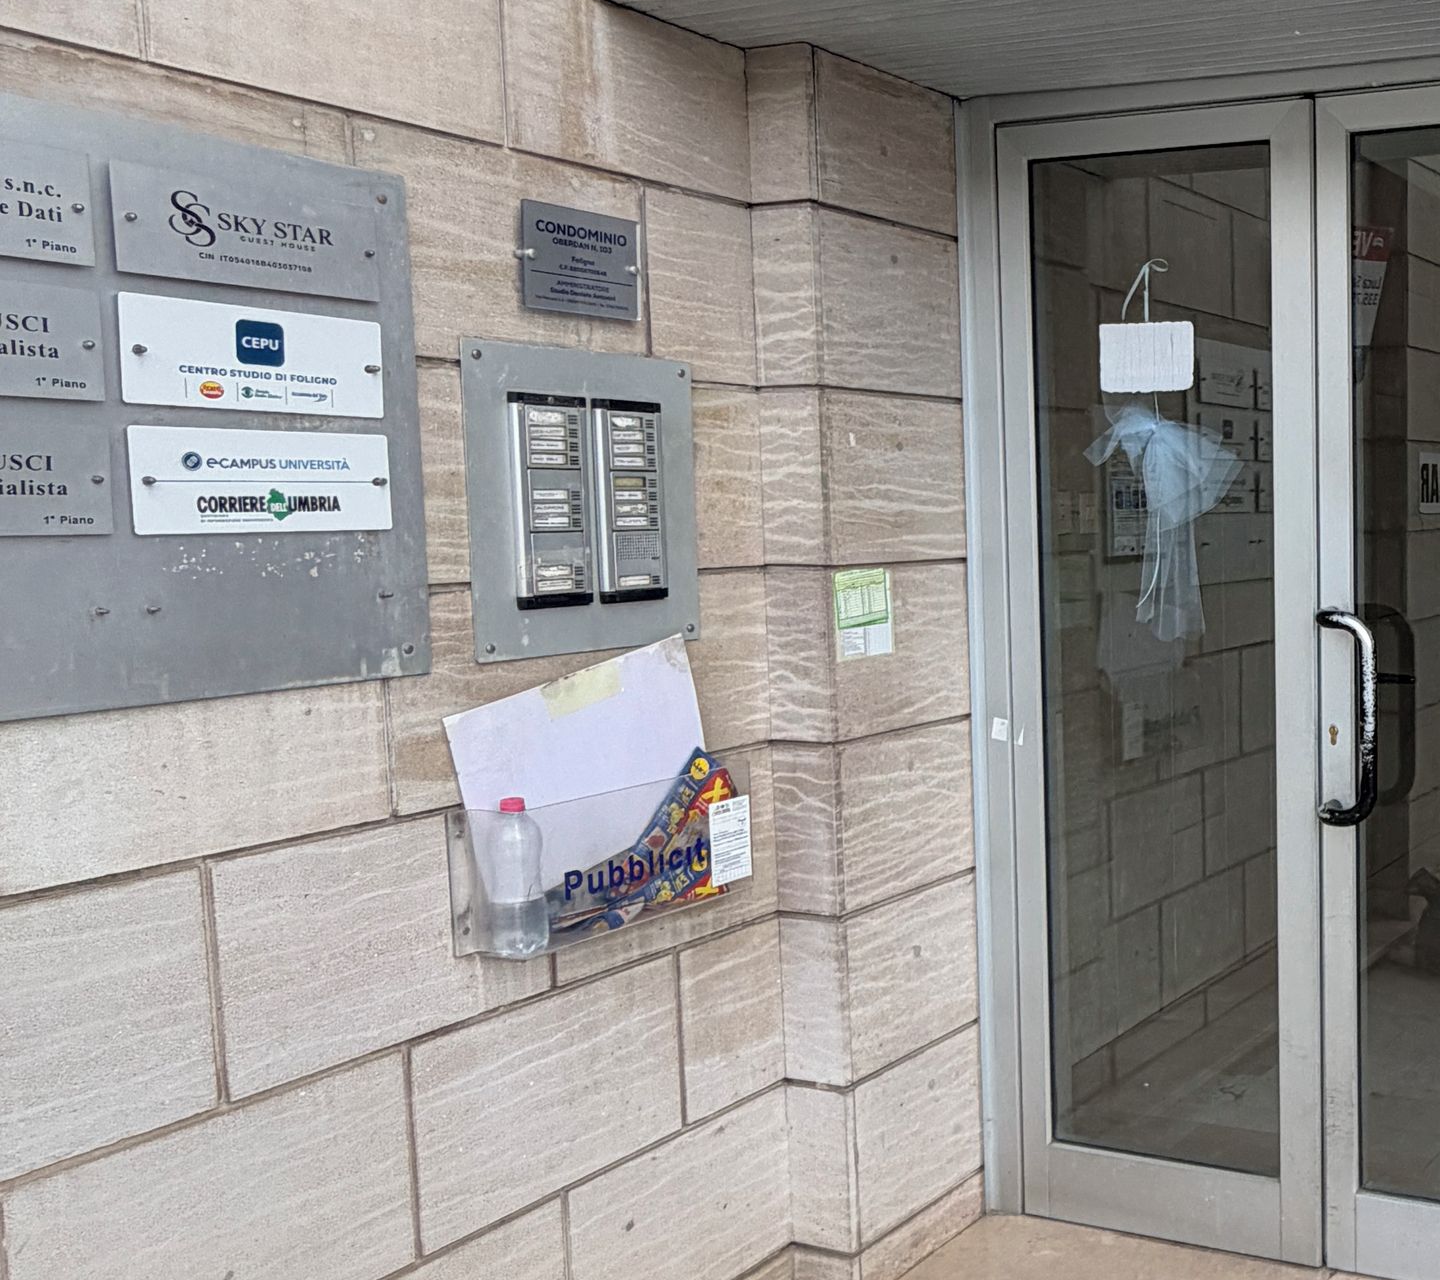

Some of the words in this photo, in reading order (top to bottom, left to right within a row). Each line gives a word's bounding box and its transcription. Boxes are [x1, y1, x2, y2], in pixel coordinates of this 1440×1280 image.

[4, 178, 61, 198] s.n.c.
[17, 200, 63, 223] Dati
[217, 213, 266, 235] SKY
[273, 221, 334, 246] STAR
[535, 219, 627, 247] CONDOMINIO
[42, 240, 77, 253] Piano
[240, 236, 275, 247] GUEST
[281, 242, 316, 252] HOUSE
[552, 237, 589, 251] OBERDAN
[199, 252, 215, 262] CIN
[0, 313, 50, 333] SCI
[241, 336, 280, 351] CEPU
[52, 377, 87, 389] Piano
[179, 364, 227, 377] CENTRO
[229, 368, 272, 380] STUDIO
[275, 373, 287, 381] DI
[290, 375, 337, 386] FOLIGNO
[279, 458, 350, 470] UNIVERSITÀ
[197, 496, 267, 513] CORRIERE
[287, 496, 341, 512] UMBRIA
[60, 515, 94, 525] Piano
[564, 836, 706, 901] Pubblicit
